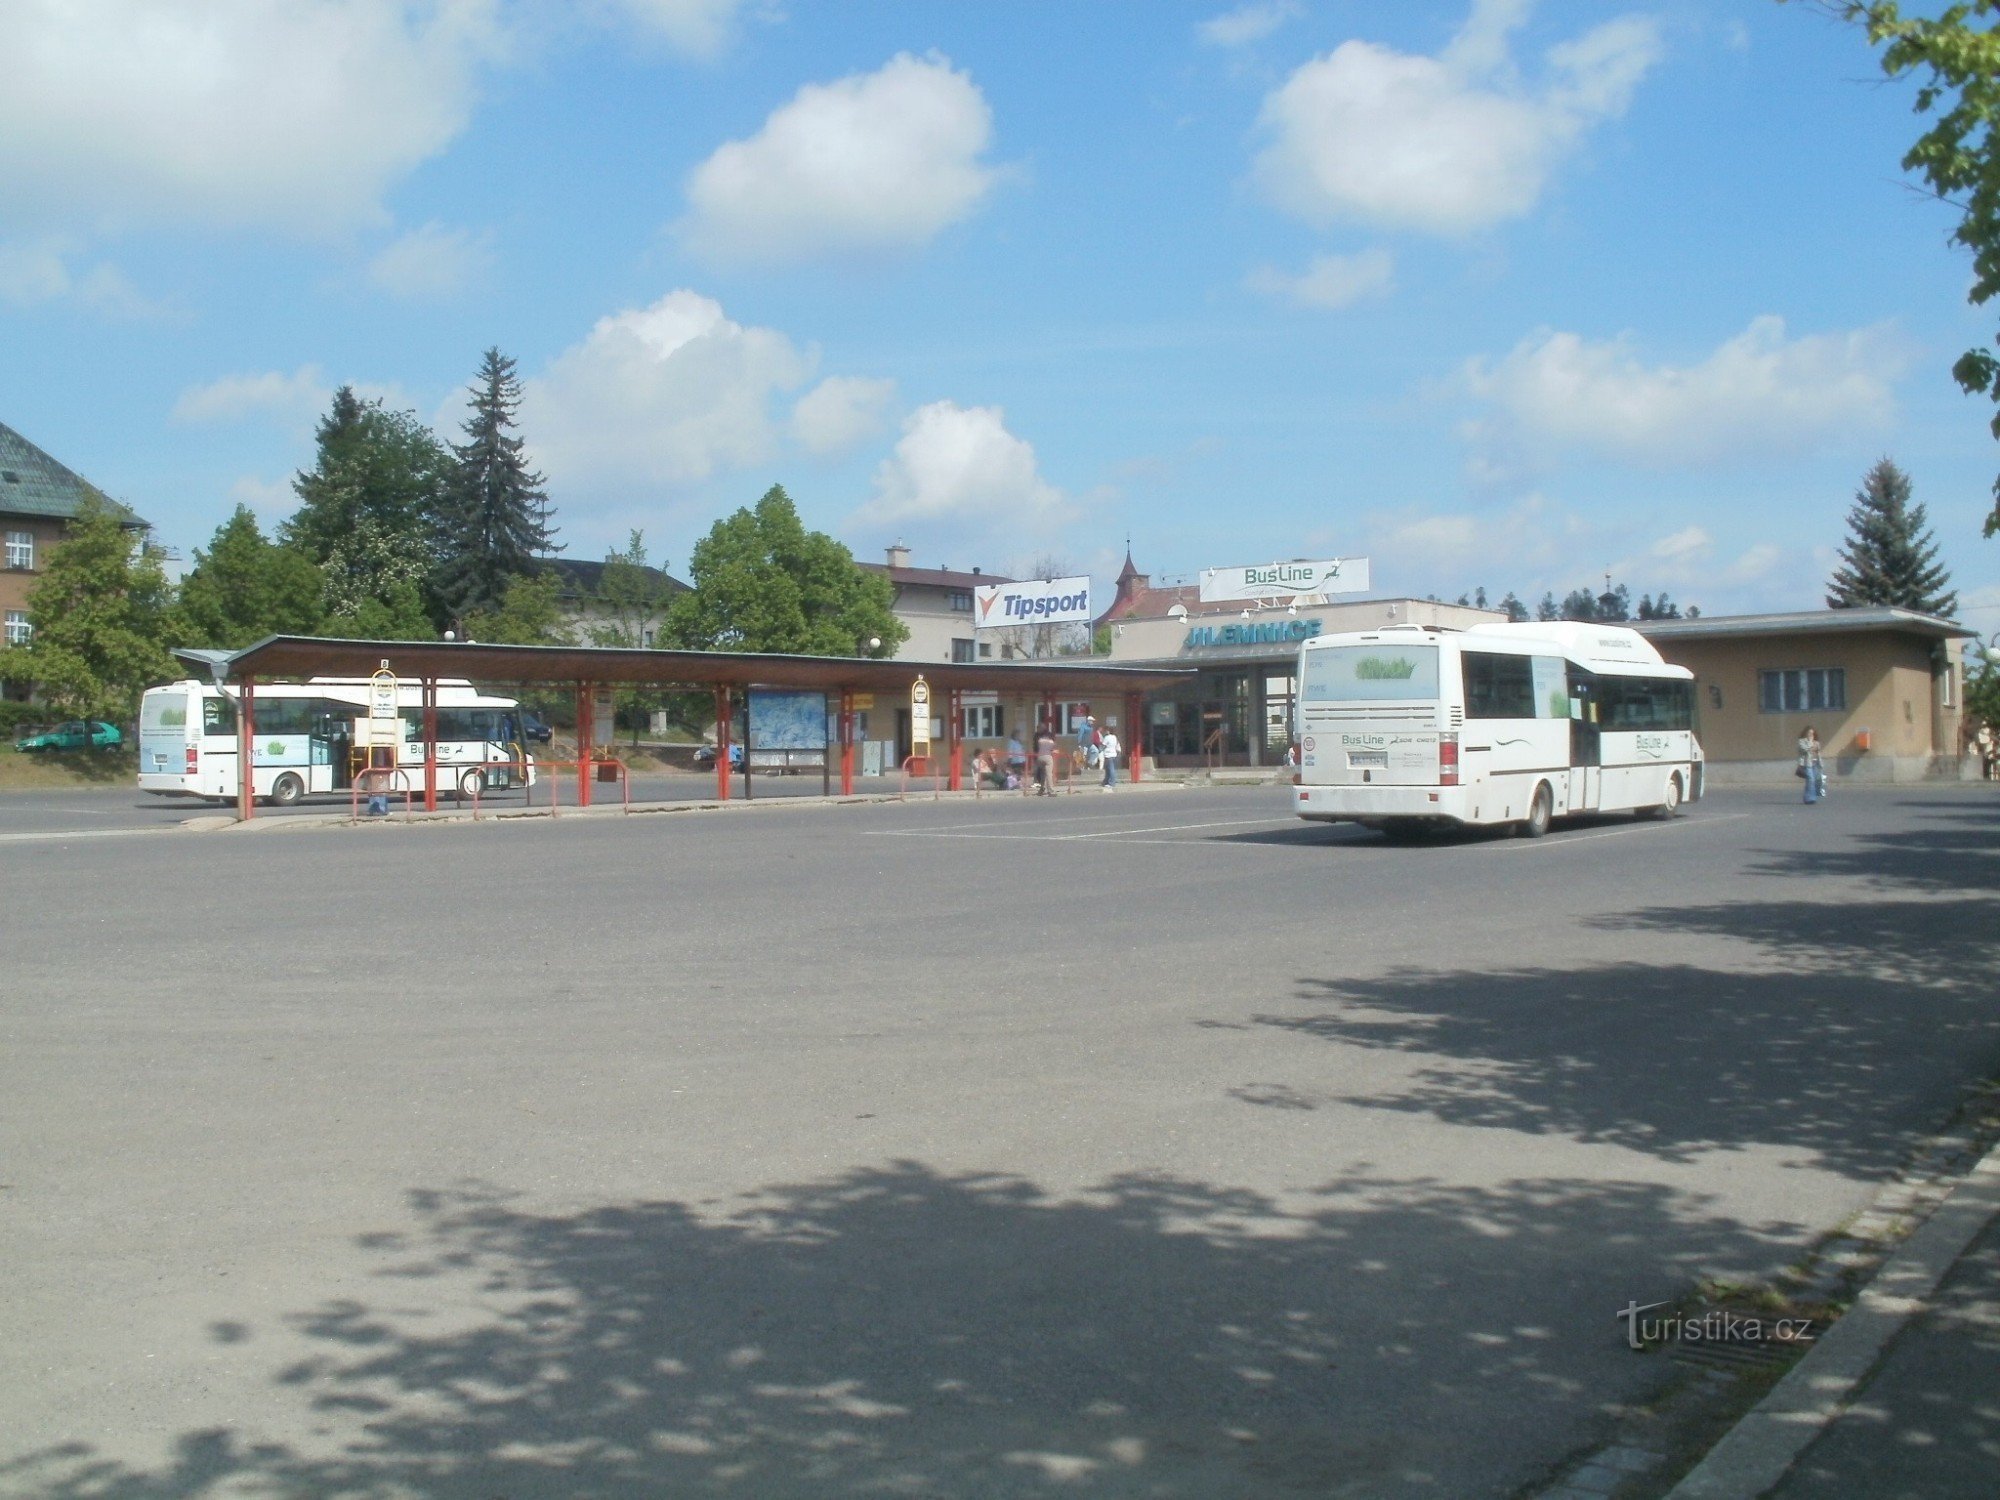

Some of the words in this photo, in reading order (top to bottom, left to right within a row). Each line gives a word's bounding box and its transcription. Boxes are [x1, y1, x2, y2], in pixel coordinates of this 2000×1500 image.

[1245, 566, 1313, 584] BusLine
[1004, 590, 1087, 620] Tipsport
[1185, 617, 1322, 647] JILEMNICE
